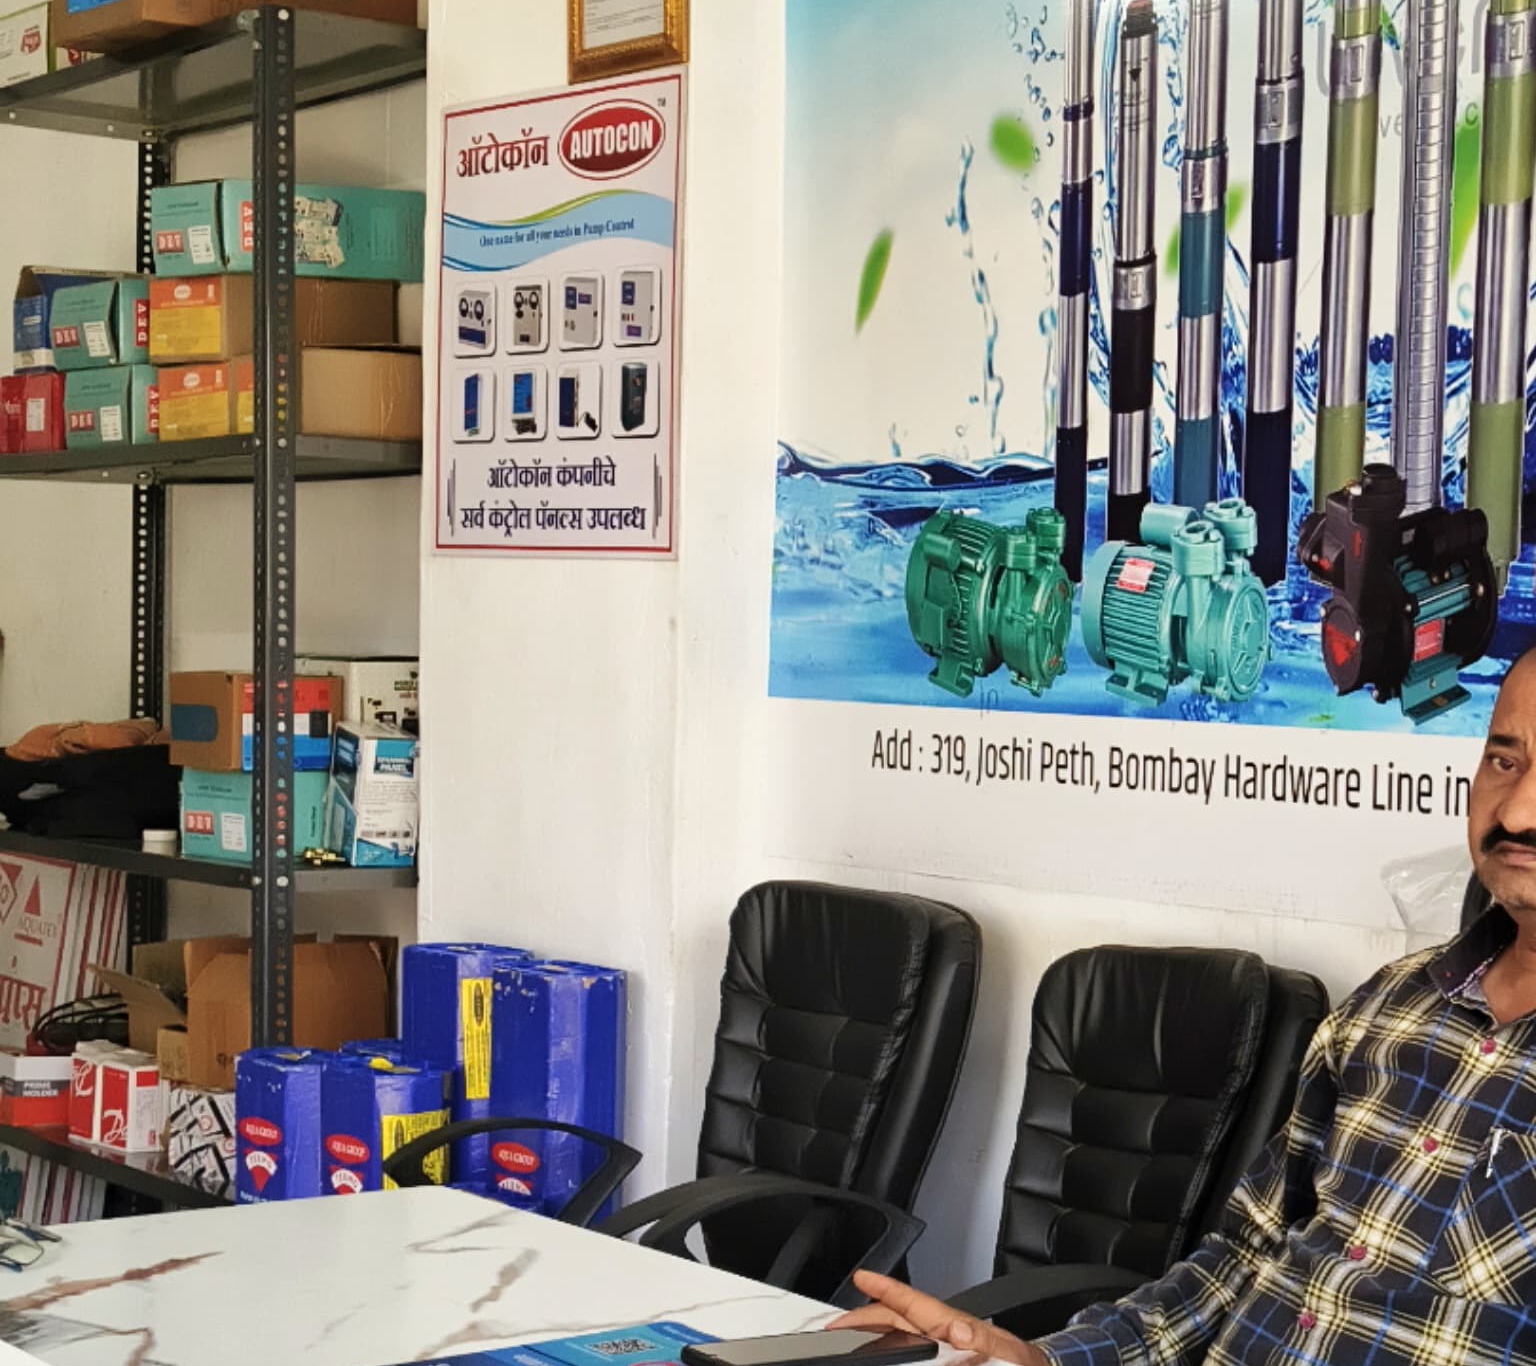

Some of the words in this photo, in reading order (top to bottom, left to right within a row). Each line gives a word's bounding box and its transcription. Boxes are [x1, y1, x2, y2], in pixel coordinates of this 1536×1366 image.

[456, 128, 550, 177] ऑटोकॉन
[570, 119, 653, 160] AUTOCON
[480, 235, 493, 247] One
[527, 230, 535, 242] all
[536, 230, 552, 243] your
[553, 228, 572, 238] needs
[574, 223, 581, 236] in
[584, 222, 603, 236] Pump
[606, 218, 634, 232] Control
[488, 459, 552, 488] ऑटोकॉन
[556, 455, 617, 487] कंपनीचे
[460, 501, 485, 529] सर्व
[587, 506, 647, 531] उपलब्ध
[871, 729, 912, 772] Add
[930, 735, 970, 782] 319,
[976, 737, 1033, 786] Joshi
[1040, 742, 1100, 792] Peth,
[1107, 747, 1215, 805] Bombay
[1223, 754, 1361, 809] Hardware
[1371, 762, 1433, 815] Line
